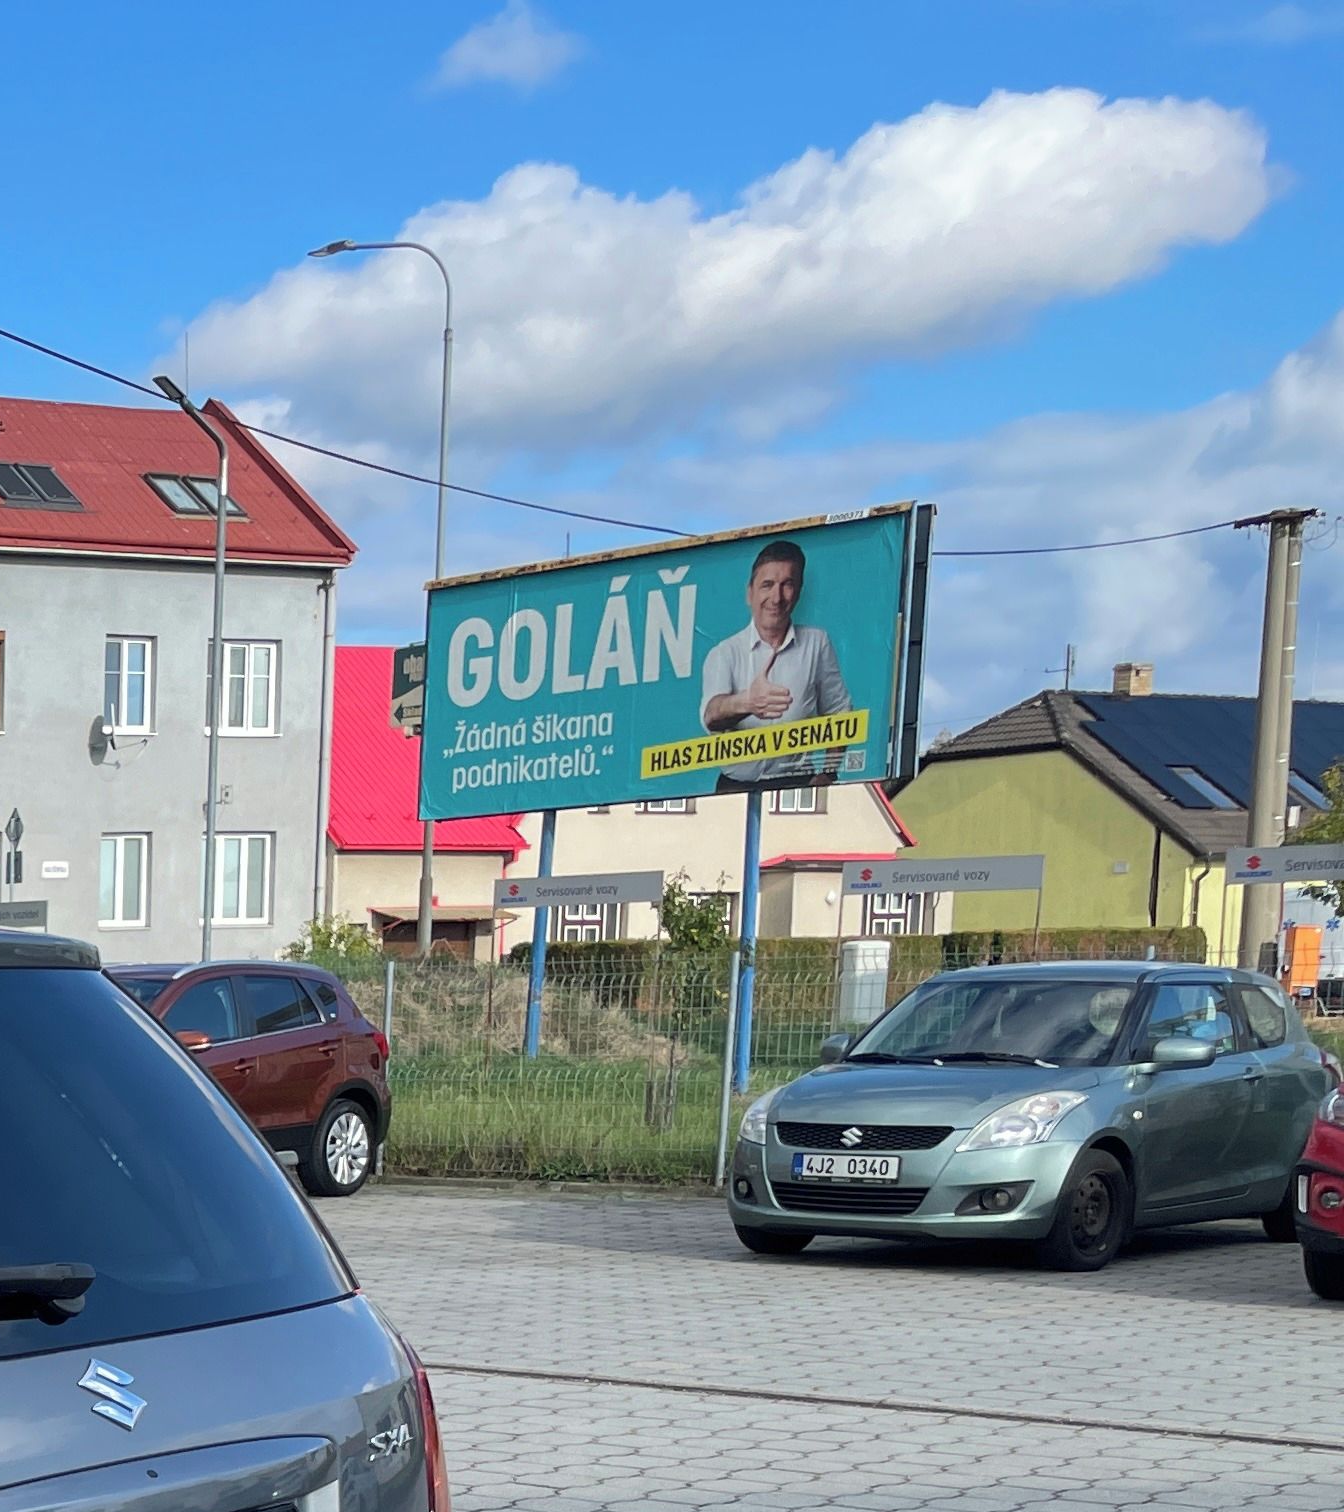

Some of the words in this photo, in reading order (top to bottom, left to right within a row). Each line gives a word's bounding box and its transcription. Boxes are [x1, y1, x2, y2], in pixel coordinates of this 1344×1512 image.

[447, 565, 697, 708] GOLÁŇ
[531, 711, 613, 744] šikana
[650, 747, 692, 772] HLAS
[696, 734, 767, 763] ZLÍNSKA
[772, 731, 784, 750] V
[787, 717, 858, 748] SENÁTU
[892, 869, 960, 884] Servisované
[963, 870, 991, 882] vozy
[535, 886, 594, 898] Servisované
[595, 885, 620, 897] vozy
[806, 1157, 835, 1174] 4J2
[847, 1158, 890, 1176] 0340
